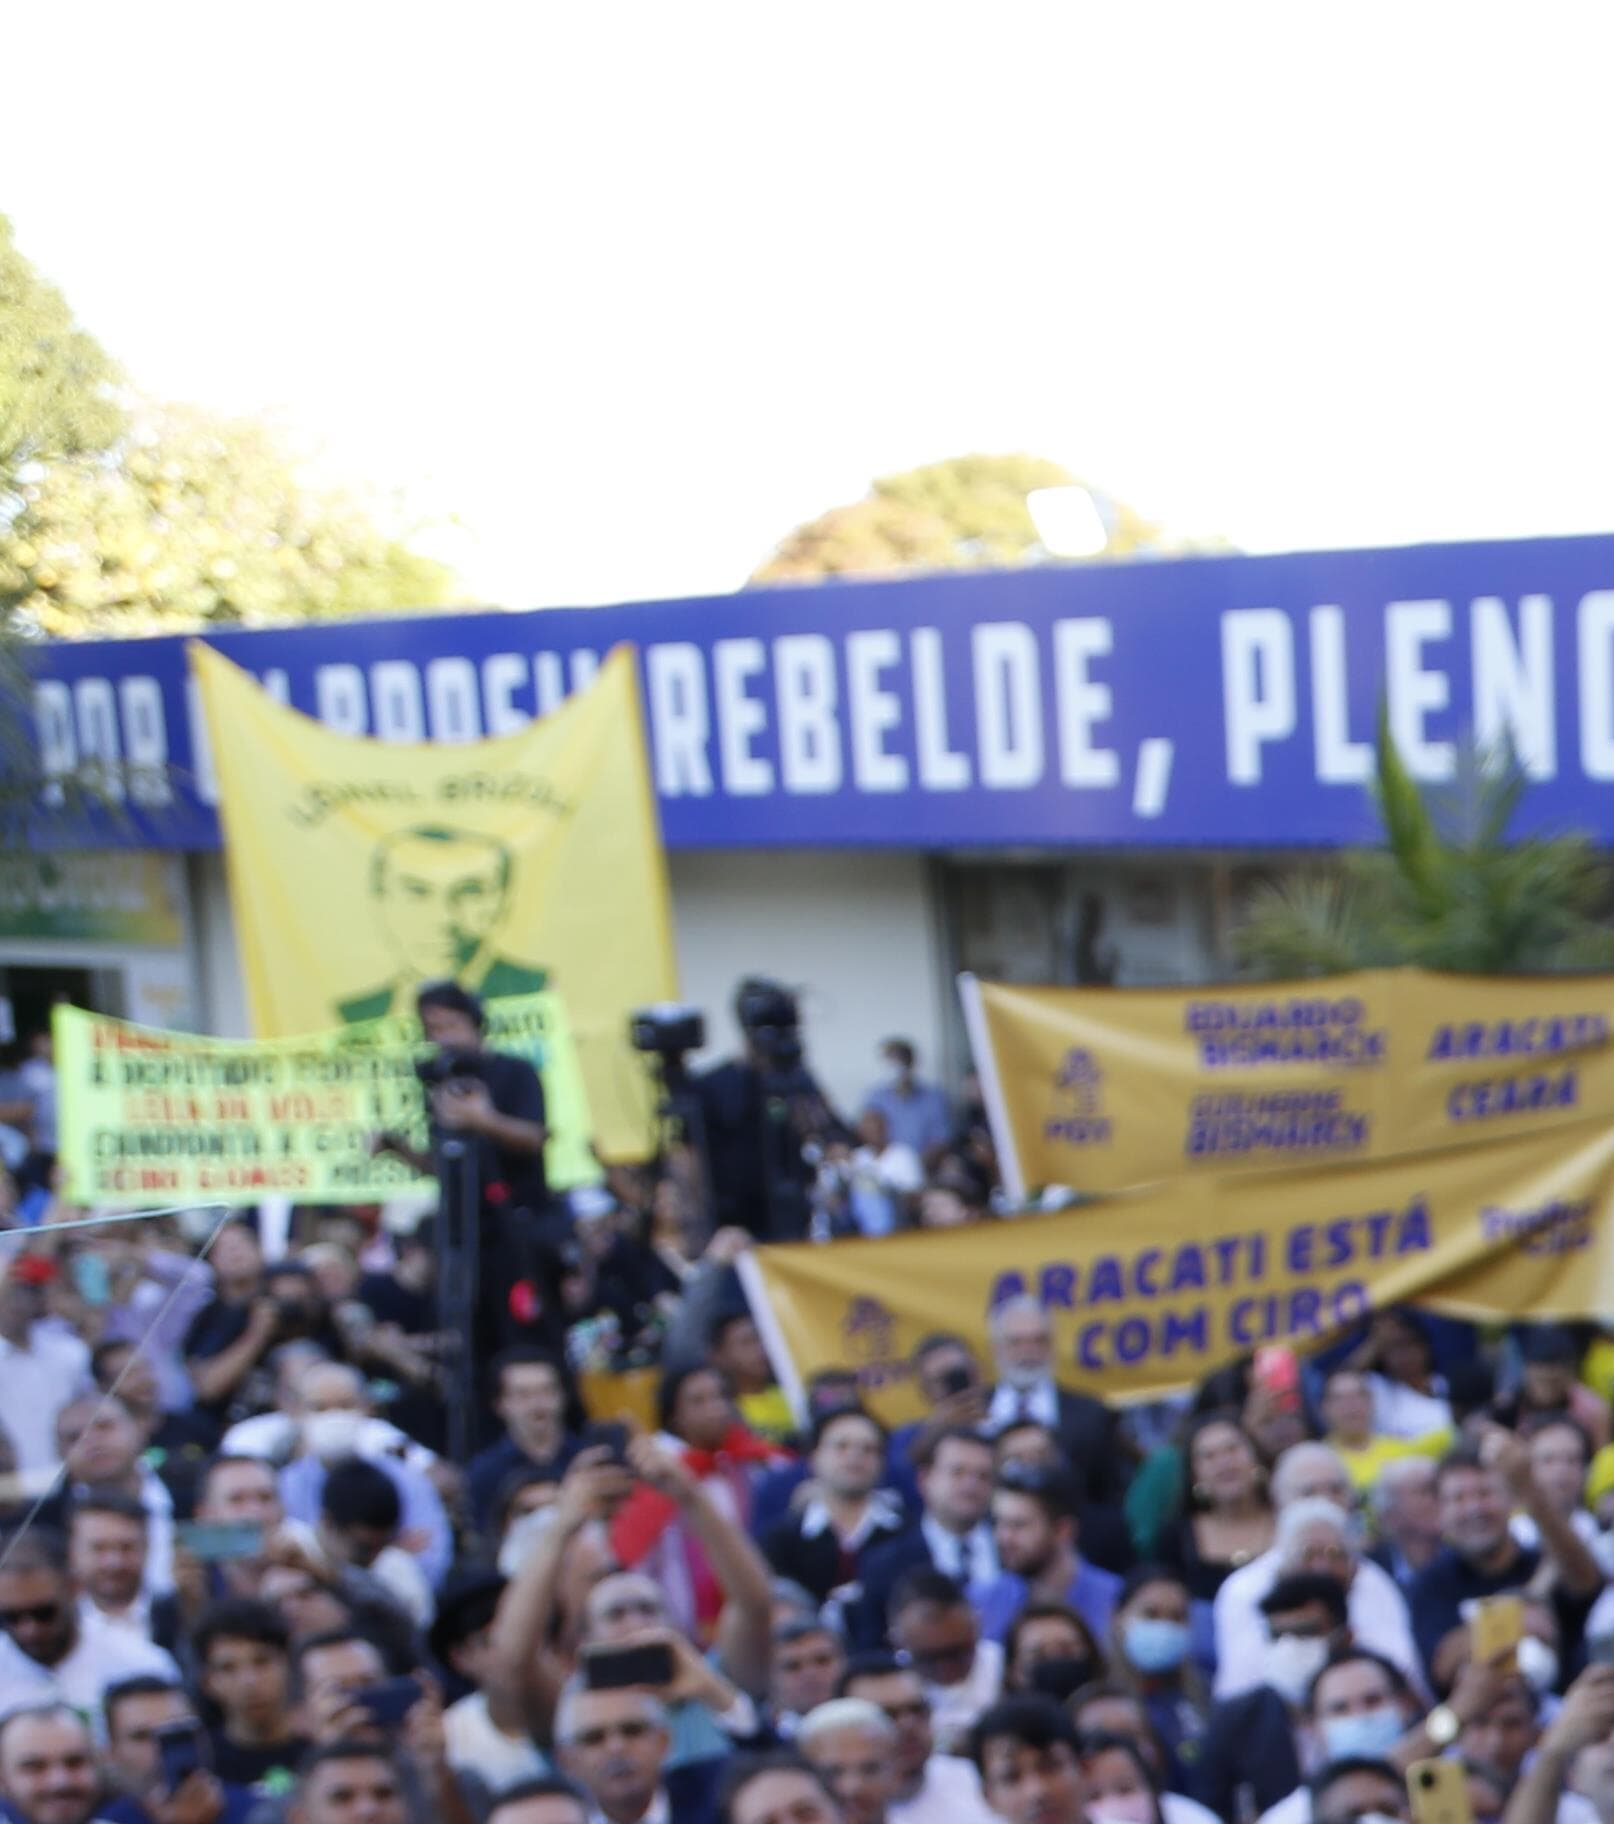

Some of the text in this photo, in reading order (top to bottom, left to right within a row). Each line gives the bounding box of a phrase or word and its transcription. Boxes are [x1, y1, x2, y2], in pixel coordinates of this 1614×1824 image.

[646, 615, 1174, 818] REBELDE,
[1428, 1014, 1611, 1061] ARACATI
[988, 1194, 1433, 1314] ARACATI ESTÁ
[1077, 1278, 1372, 1371] COM CIRO
